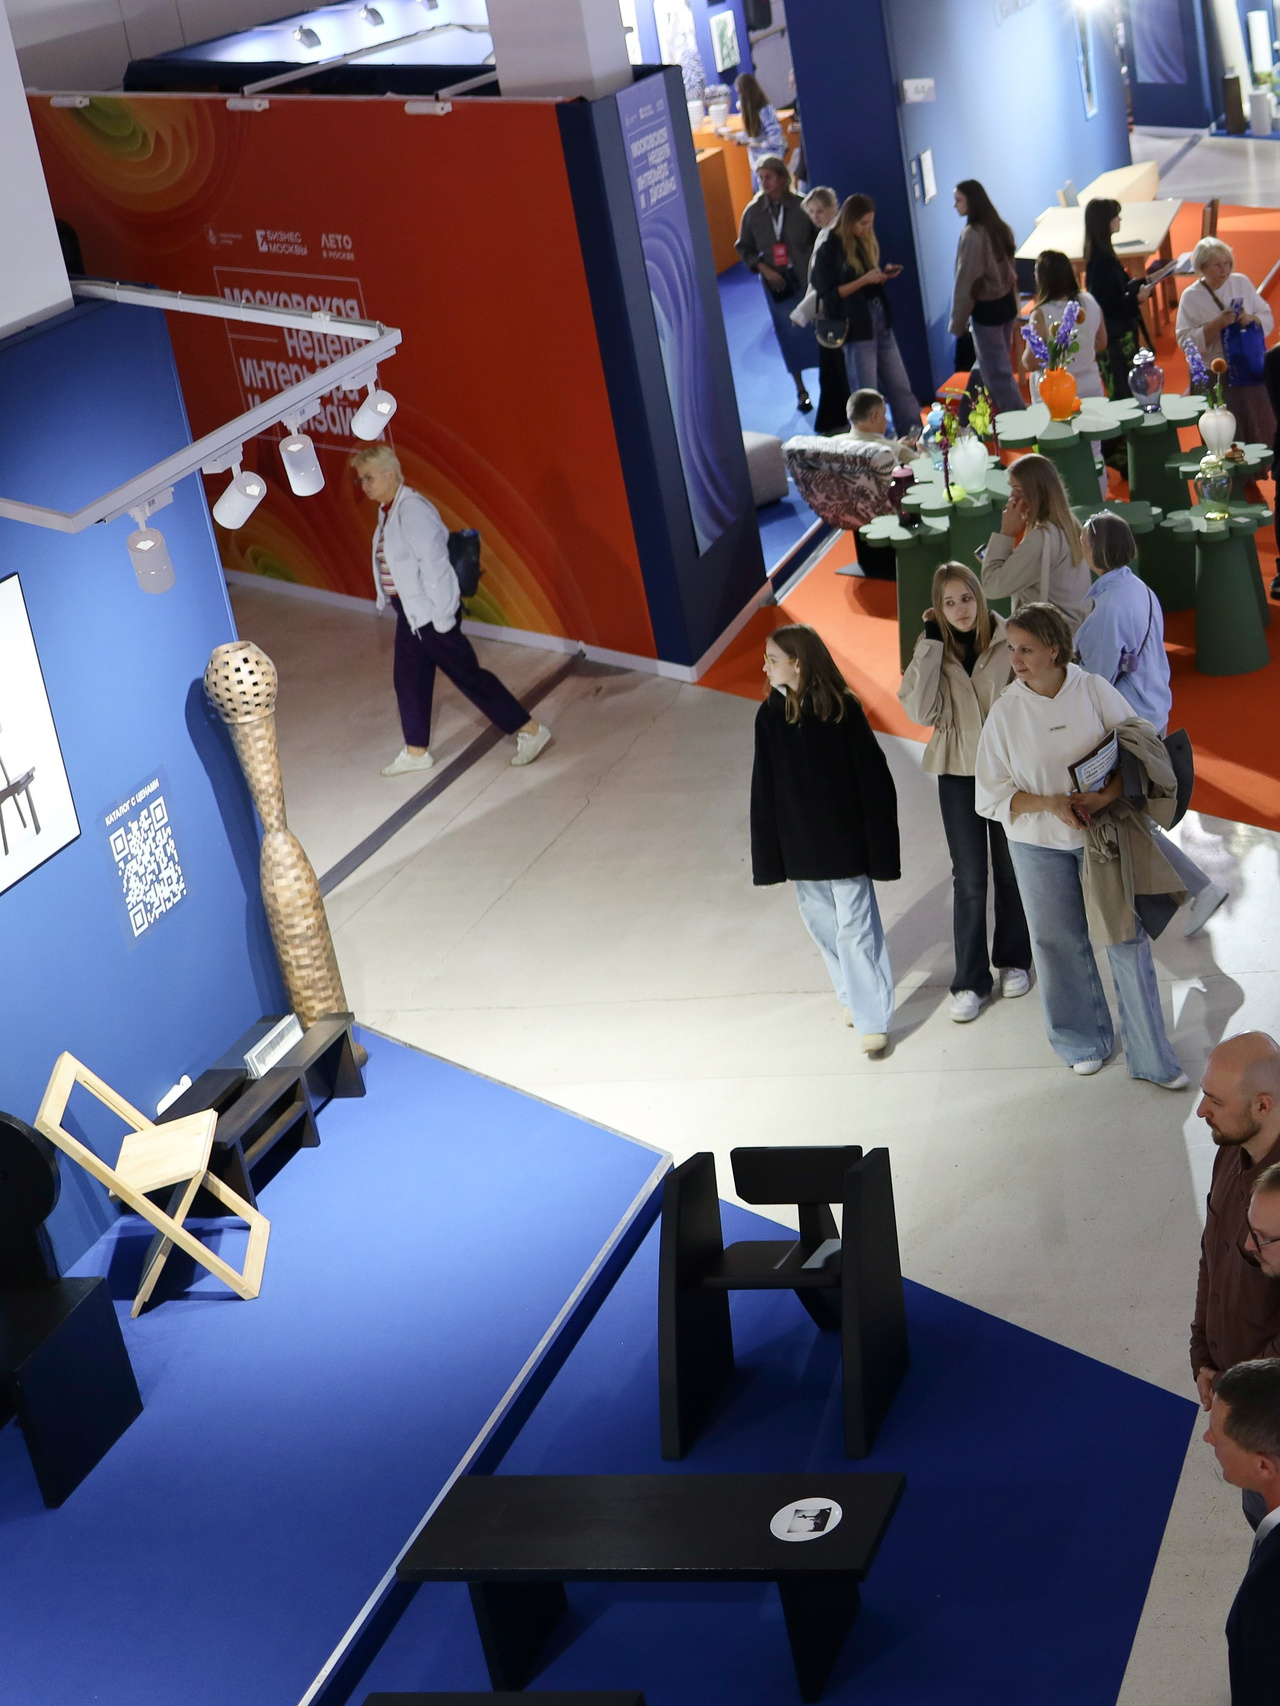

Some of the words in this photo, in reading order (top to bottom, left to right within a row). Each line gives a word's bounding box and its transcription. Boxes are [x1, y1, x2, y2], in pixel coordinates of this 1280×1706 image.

[267, 230, 302, 243] БИЗНЕС
[321, 233, 353, 250] ЛЕТО
[269, 242, 308, 256] МОСКВЫ
[105, 799, 131, 827] КАТАЛОГ
[131, 797, 136, 807] С
[135, 777, 160, 804] ЦЕНАМИ
